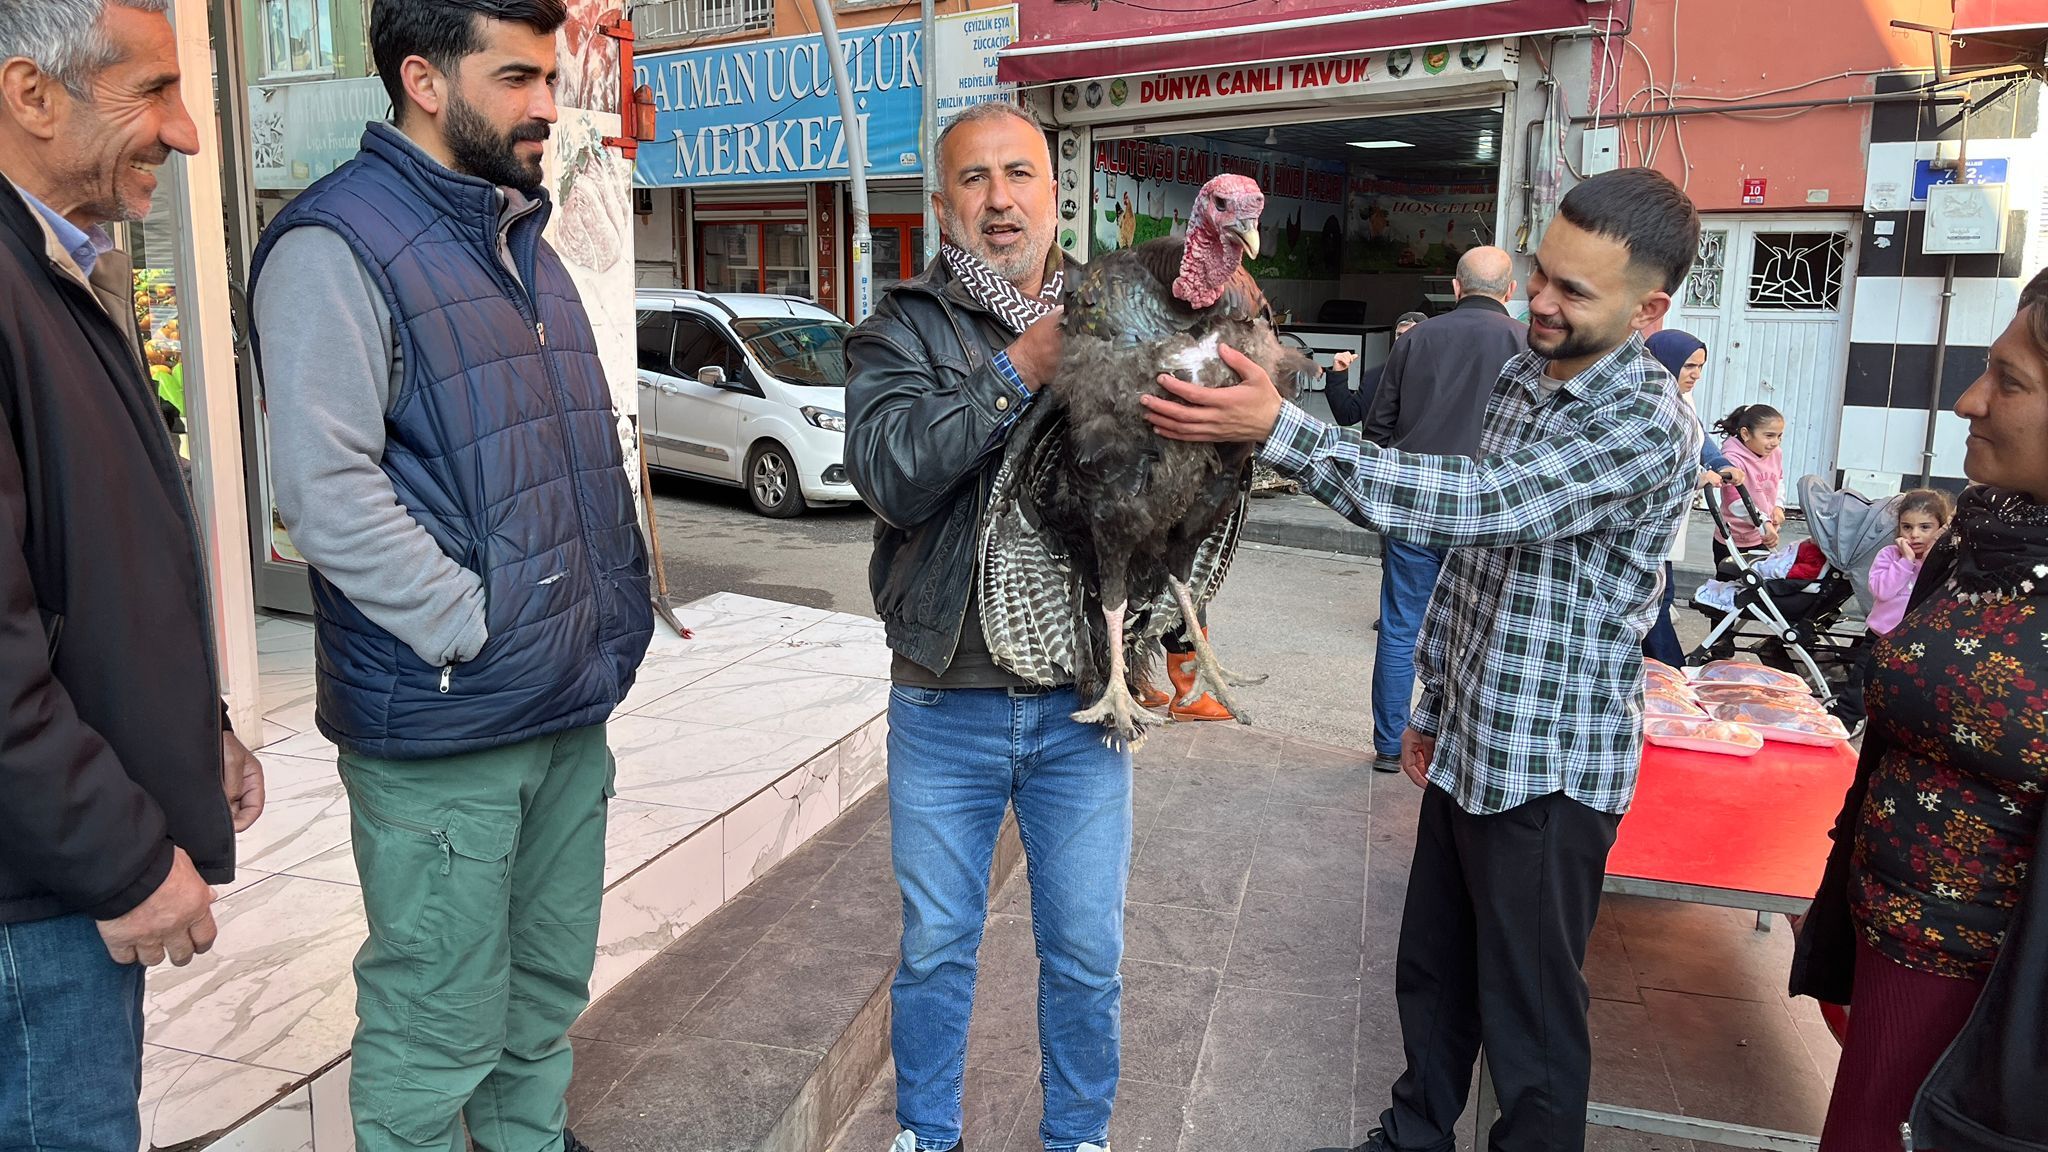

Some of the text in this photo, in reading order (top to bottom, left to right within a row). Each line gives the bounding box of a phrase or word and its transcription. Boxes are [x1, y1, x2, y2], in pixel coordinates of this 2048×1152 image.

[964, 16, 1010, 36] ÇEYİZLİK EŞYA
[973, 34, 1010, 51] ZÜCCACİYE
[959, 73, 993, 89] HEDİYELİK
[1140, 57, 1370, 104] DÜNYA CANLI TAVUK
[672, 97, 872, 179] MERKEZİ
[1944, 168, 1983, 179] 72.
[1749, 186, 1760, 195] 10
